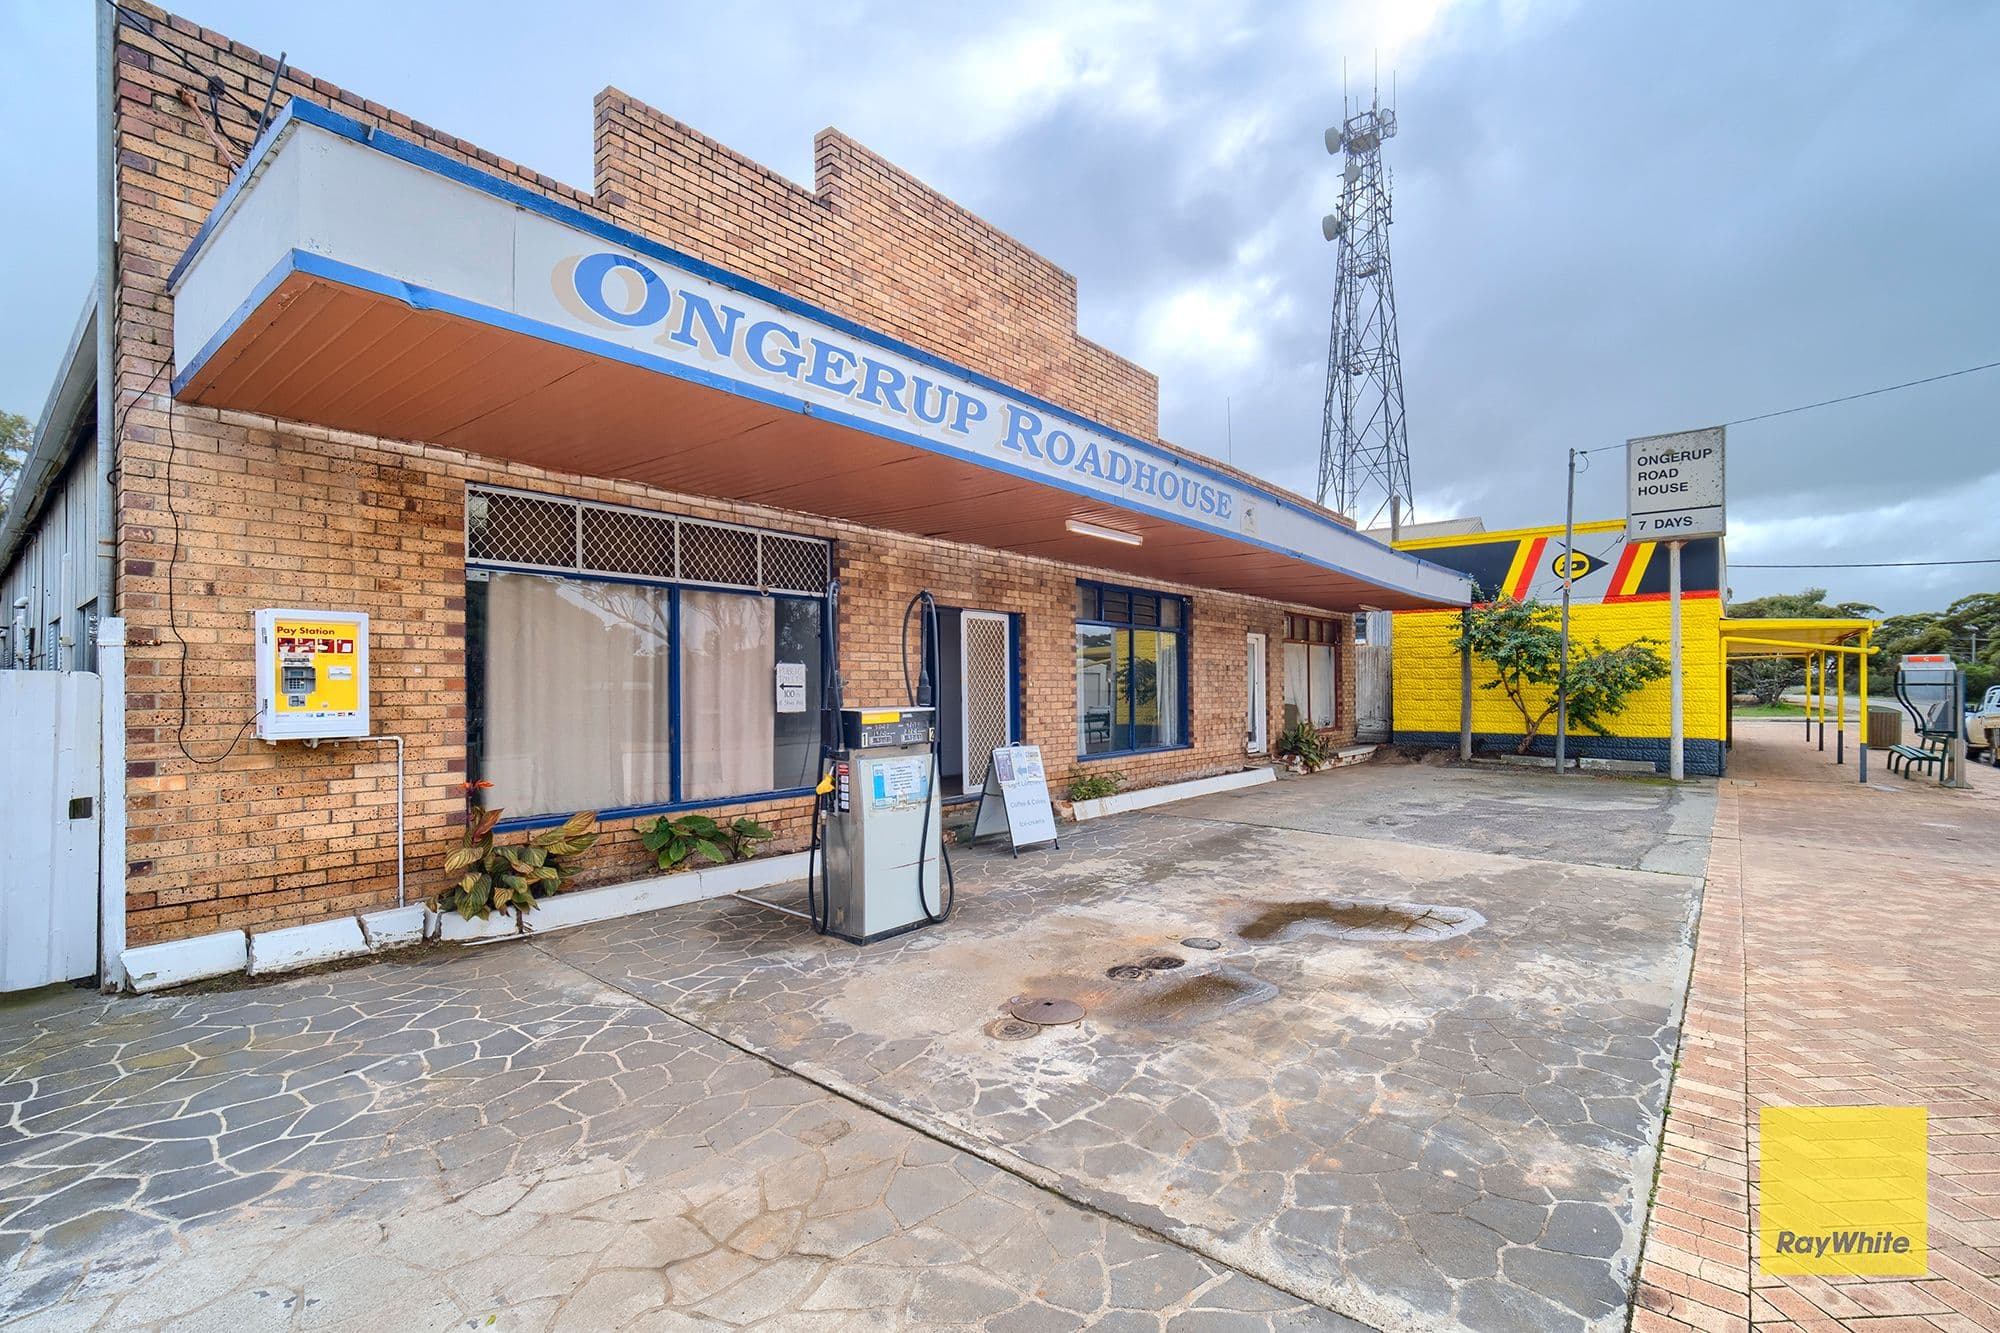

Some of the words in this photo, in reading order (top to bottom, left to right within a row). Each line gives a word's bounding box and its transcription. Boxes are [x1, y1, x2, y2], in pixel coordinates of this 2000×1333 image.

[573, 252, 988, 435] ONGERUP
[1002, 403, 1232, 520] ROADHOUSE
[1637, 448, 1713, 467] ONGERUP
[1638, 468, 1679, 482] ROAD
[1638, 482, 1689, 497] HOUSE
[1638, 520, 1647, 531] 7
[1654, 515, 1693, 529] DAYS
[276, 626, 297, 636] Pay
[299, 627, 335, 635] Station
